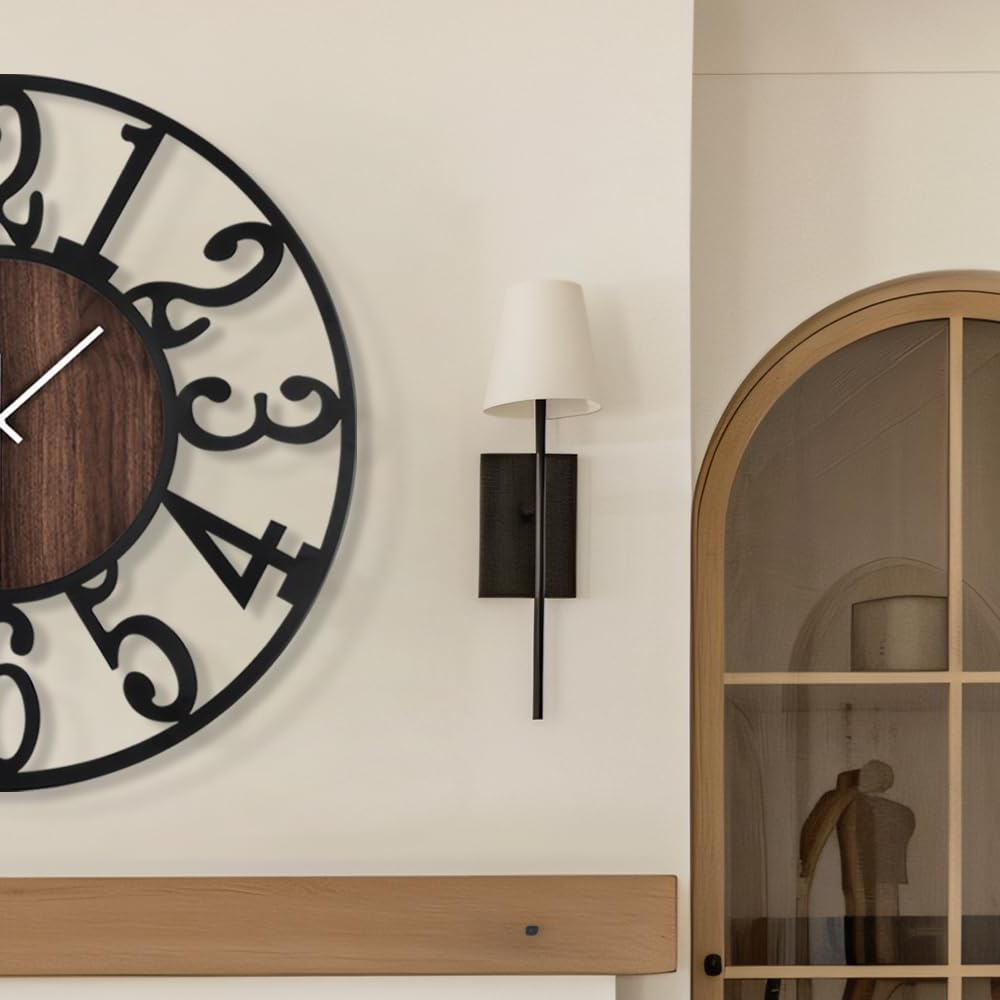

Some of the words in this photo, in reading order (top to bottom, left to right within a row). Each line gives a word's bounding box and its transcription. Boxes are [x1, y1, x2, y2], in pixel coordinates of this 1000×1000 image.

[53, 122, 166, 281] 1
[121, 221, 286, 350] 2
[175, 375, 343, 451] 3
[163, 488, 322, 610] 4
[65, 558, 198, 723] 5
